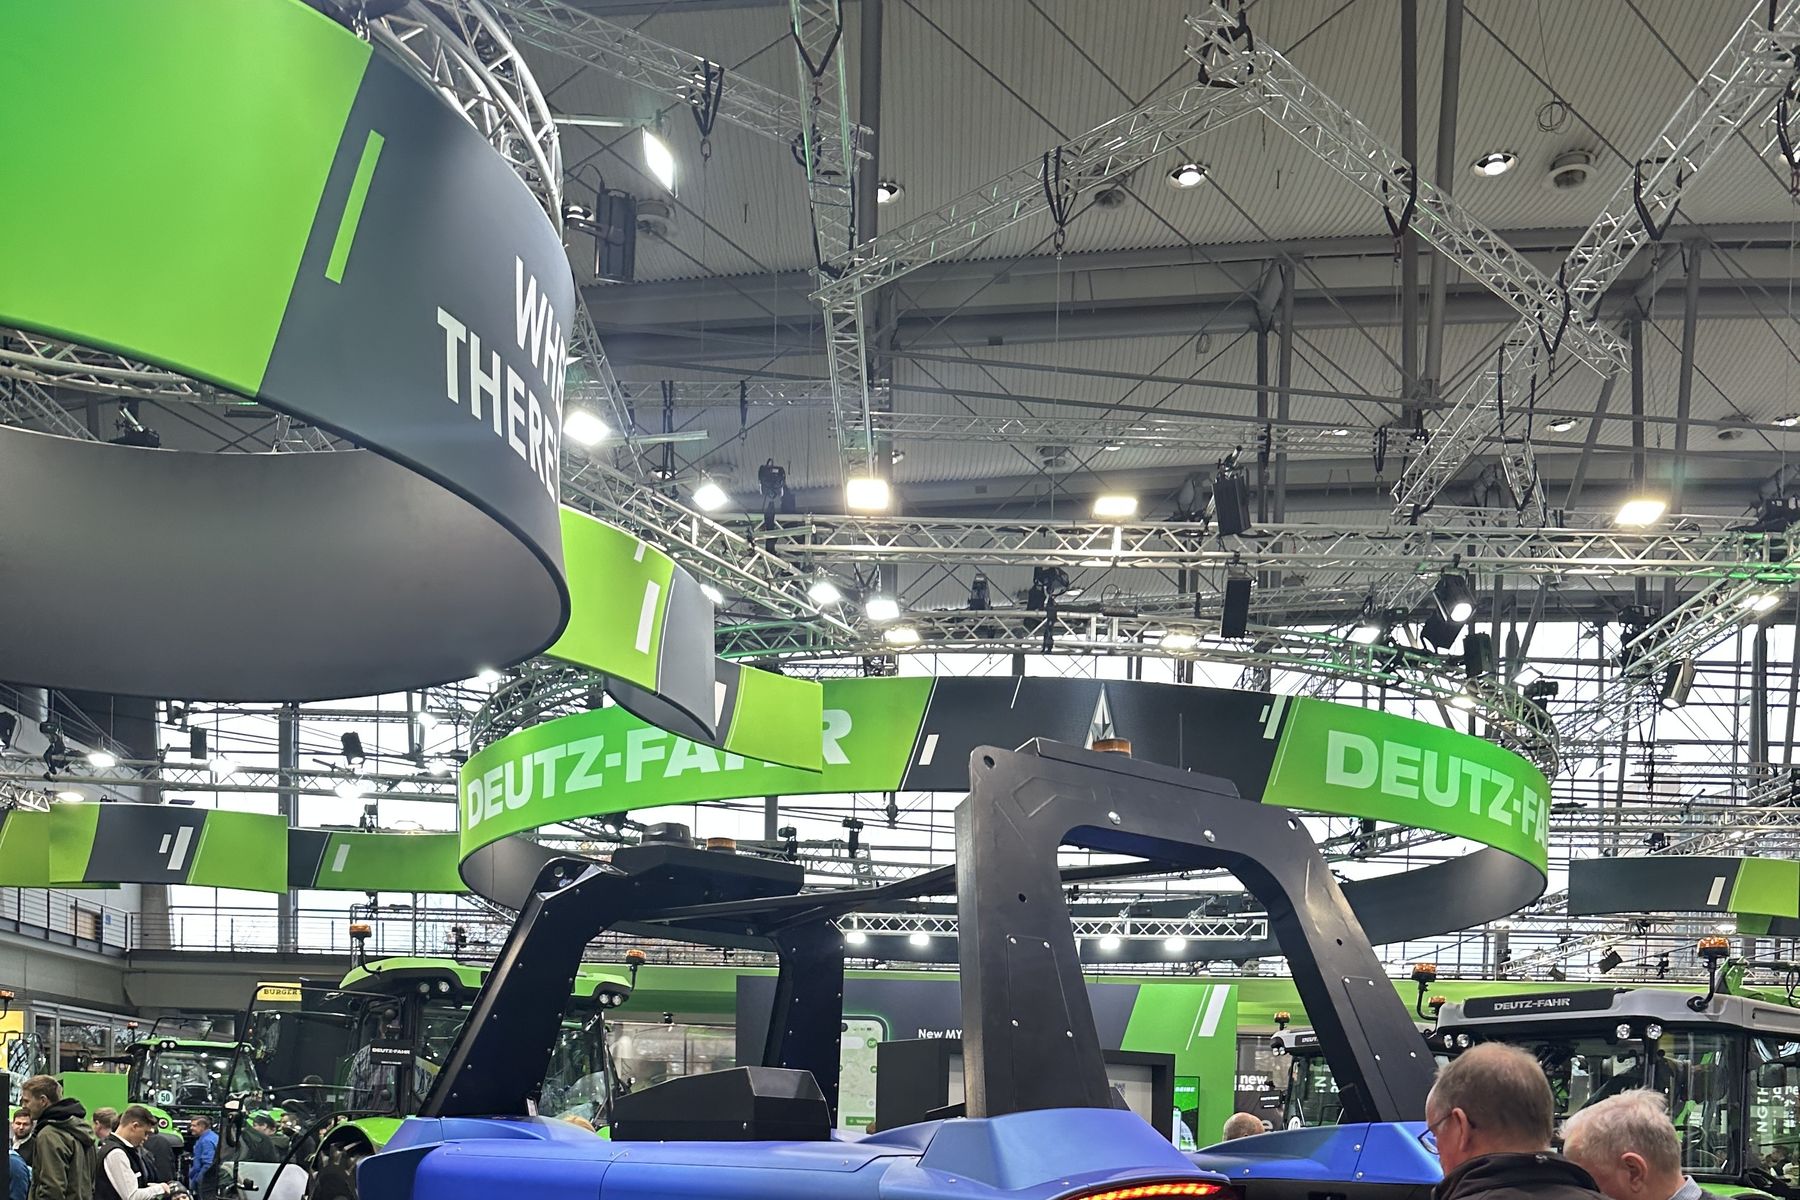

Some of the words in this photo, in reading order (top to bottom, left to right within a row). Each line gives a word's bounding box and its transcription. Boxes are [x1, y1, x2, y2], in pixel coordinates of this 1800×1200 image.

[437, 306, 560, 504] THERE'
[467, 709, 853, 830] DEUTZ-FAR
[1325, 730, 1549, 850] DEUTZ-FA
[918, 1029, 943, 1039] New
[945, 1029, 963, 1039] MY
[1494, 998, 1571, 1011] DEUTZ-FAHR
[161, 1093, 170, 1102] 50
